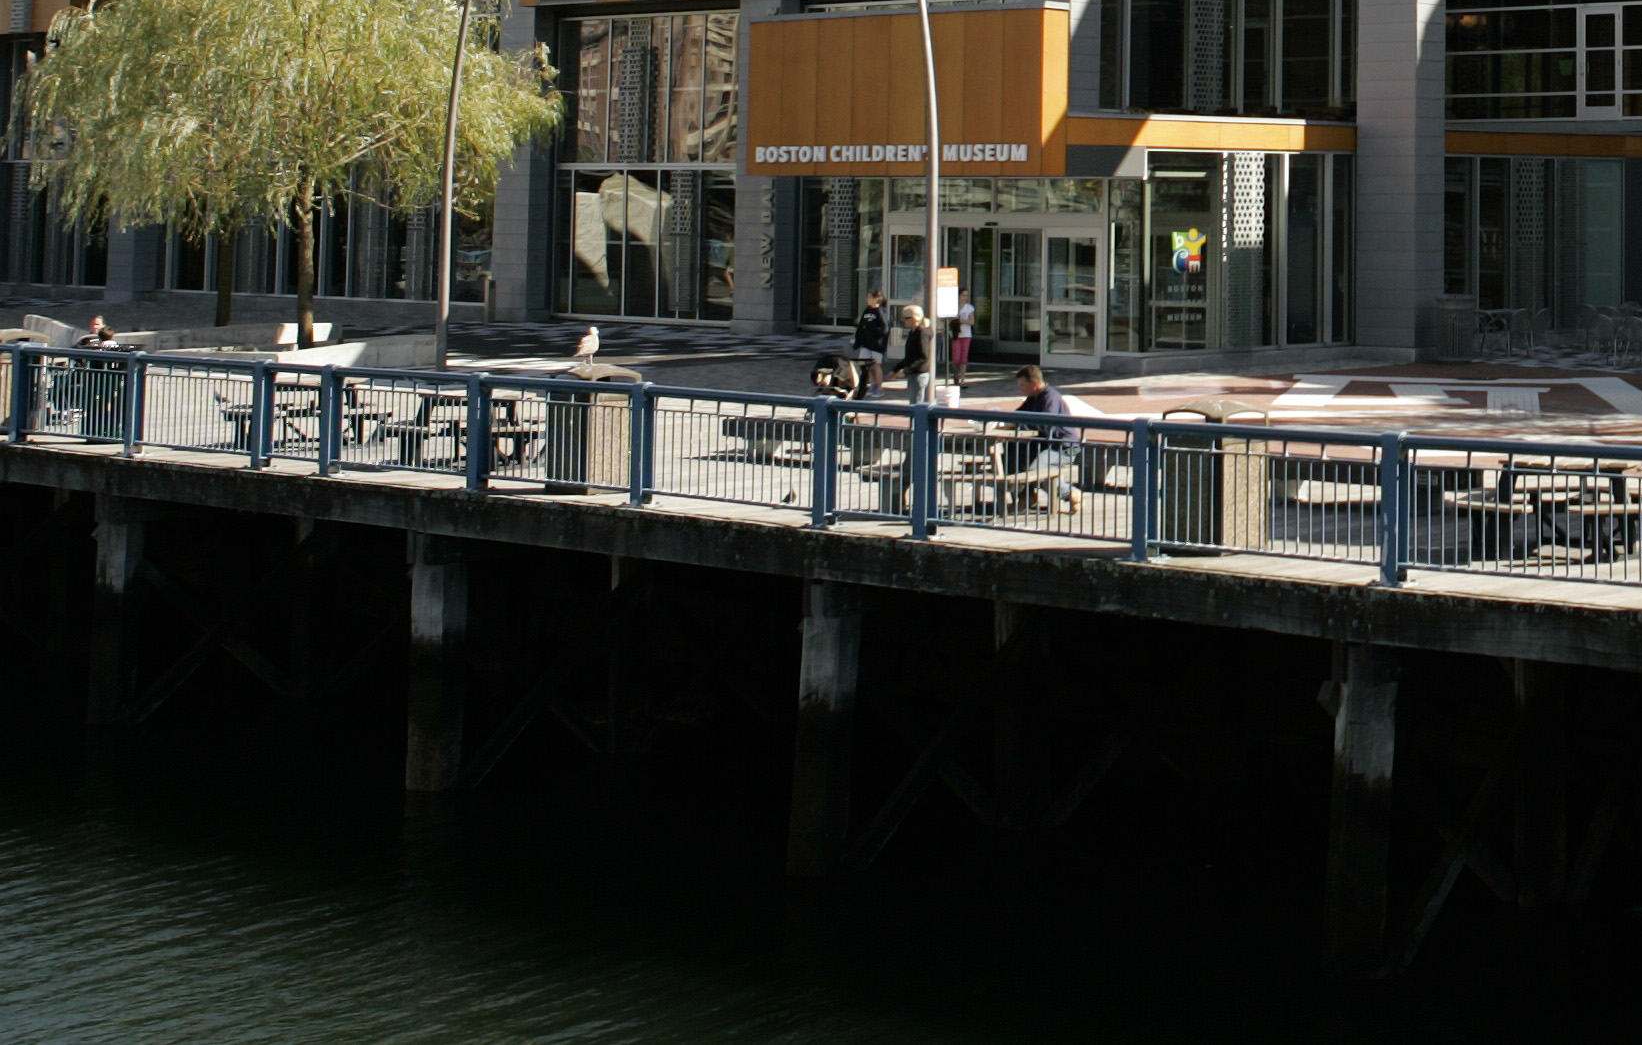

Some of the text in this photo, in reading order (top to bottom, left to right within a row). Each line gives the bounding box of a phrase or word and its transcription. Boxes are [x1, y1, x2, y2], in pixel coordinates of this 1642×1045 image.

[755, 143, 1028, 164] BOSTON CHILDREN' MUSEUM
[759, 178, 775, 290] NEW BAL
